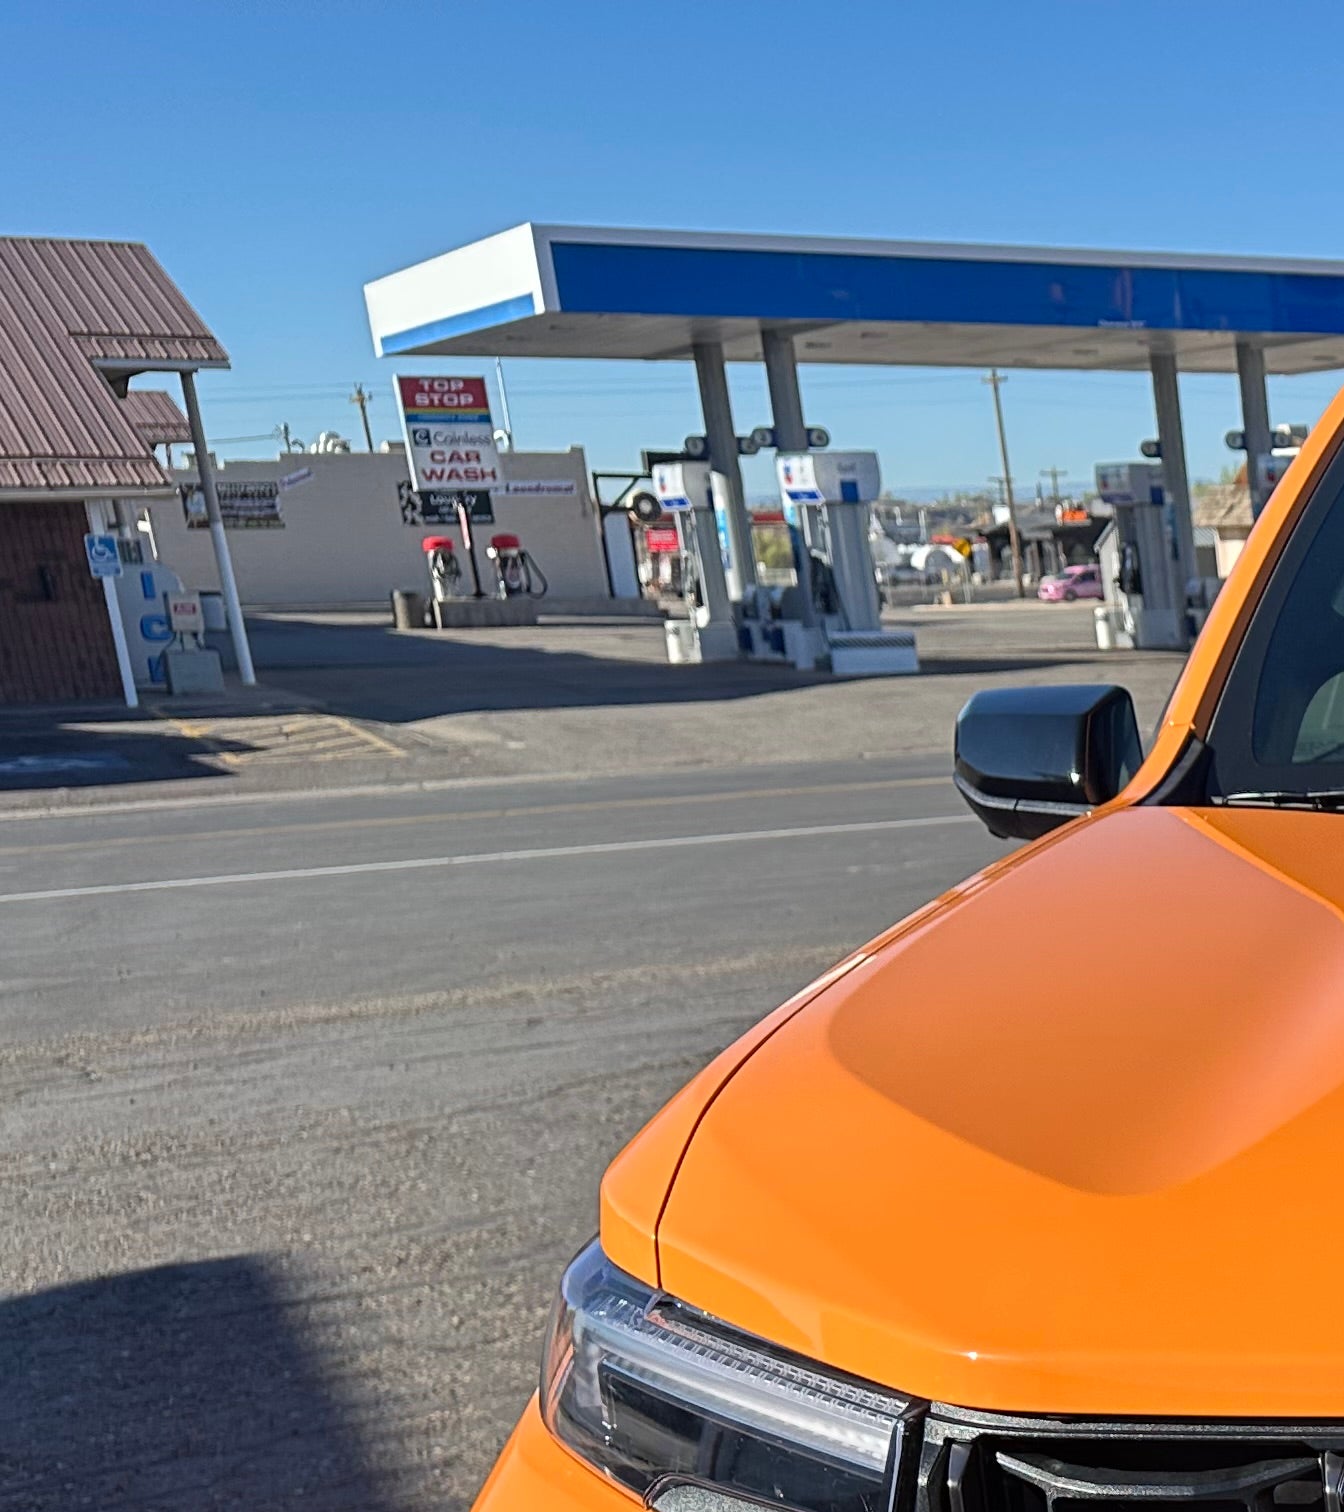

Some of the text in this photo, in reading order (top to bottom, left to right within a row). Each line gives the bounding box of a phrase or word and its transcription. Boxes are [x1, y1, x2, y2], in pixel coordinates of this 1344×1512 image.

[419, 379, 464, 393] TOP
[415, 393, 473, 407] STOP
[430, 450, 480, 465] CAR
[421, 467, 497, 482] WASH
